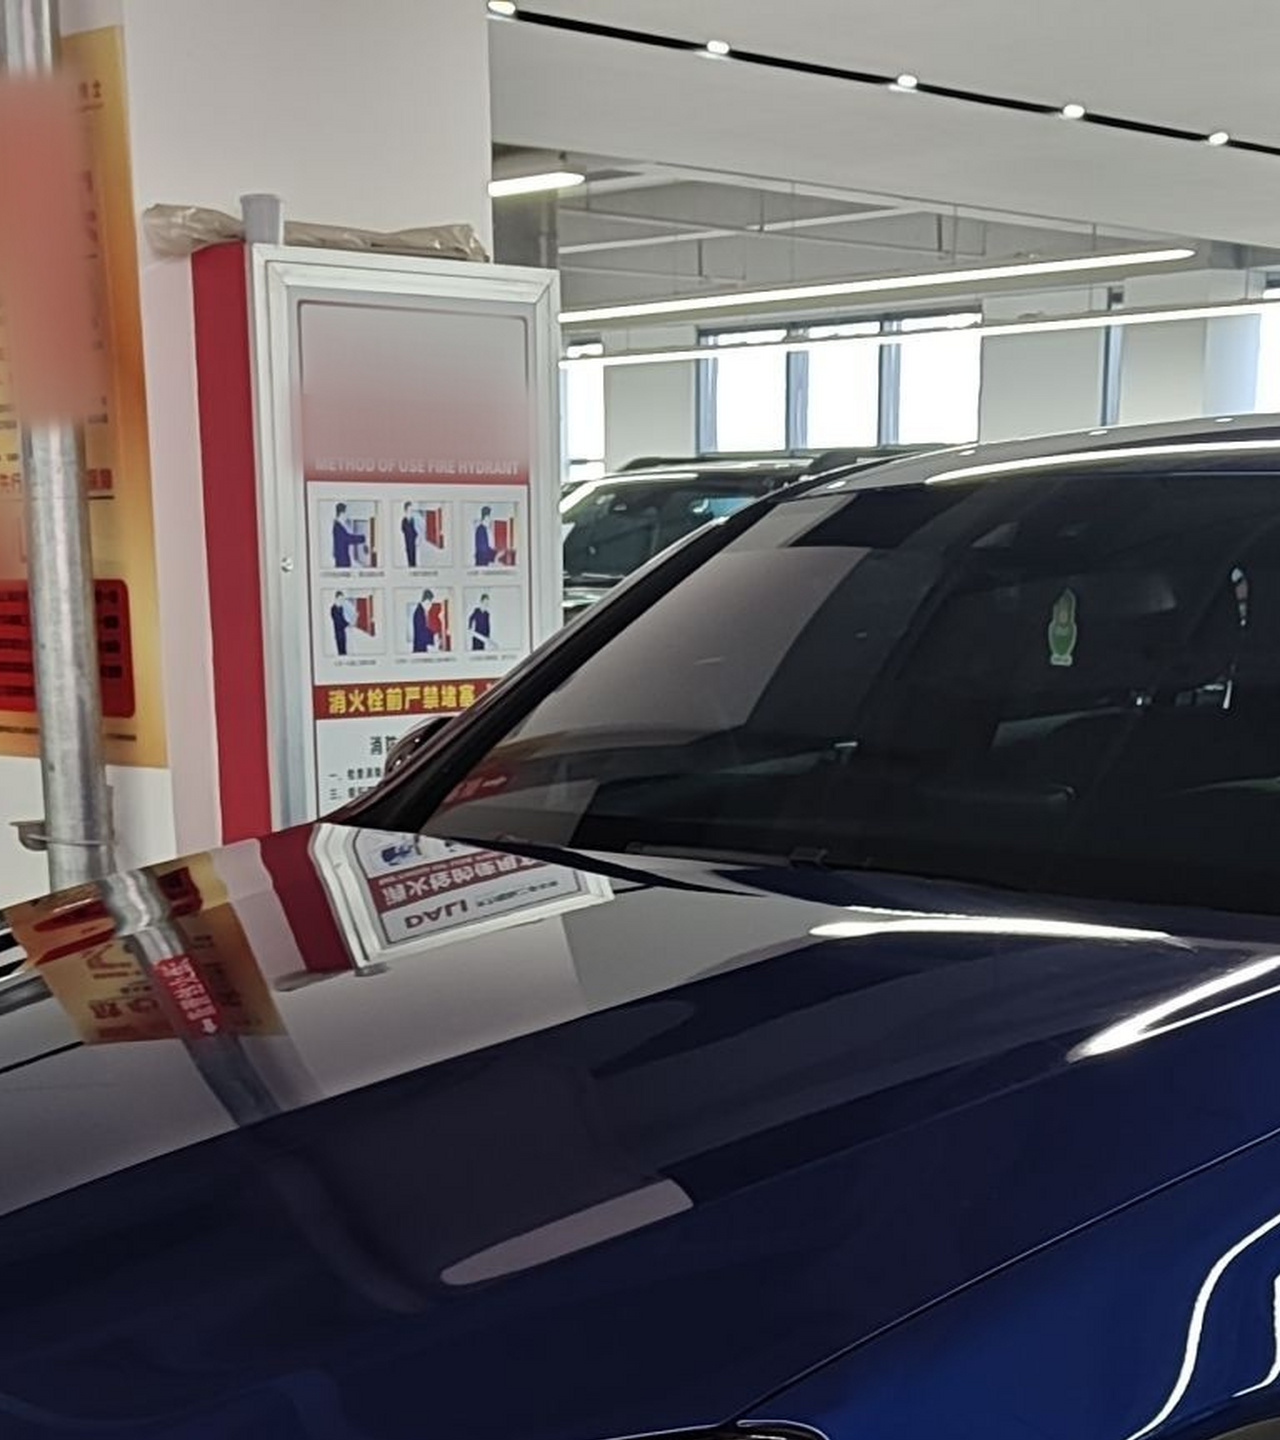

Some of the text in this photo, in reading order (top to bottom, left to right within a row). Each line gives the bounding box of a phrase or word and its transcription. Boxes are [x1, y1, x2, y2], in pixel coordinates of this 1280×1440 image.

[378, 457, 395, 473] OF
[398, 458, 425, 474] USE
[328, 684, 476, 714] 消火栓前严禁堵塞
